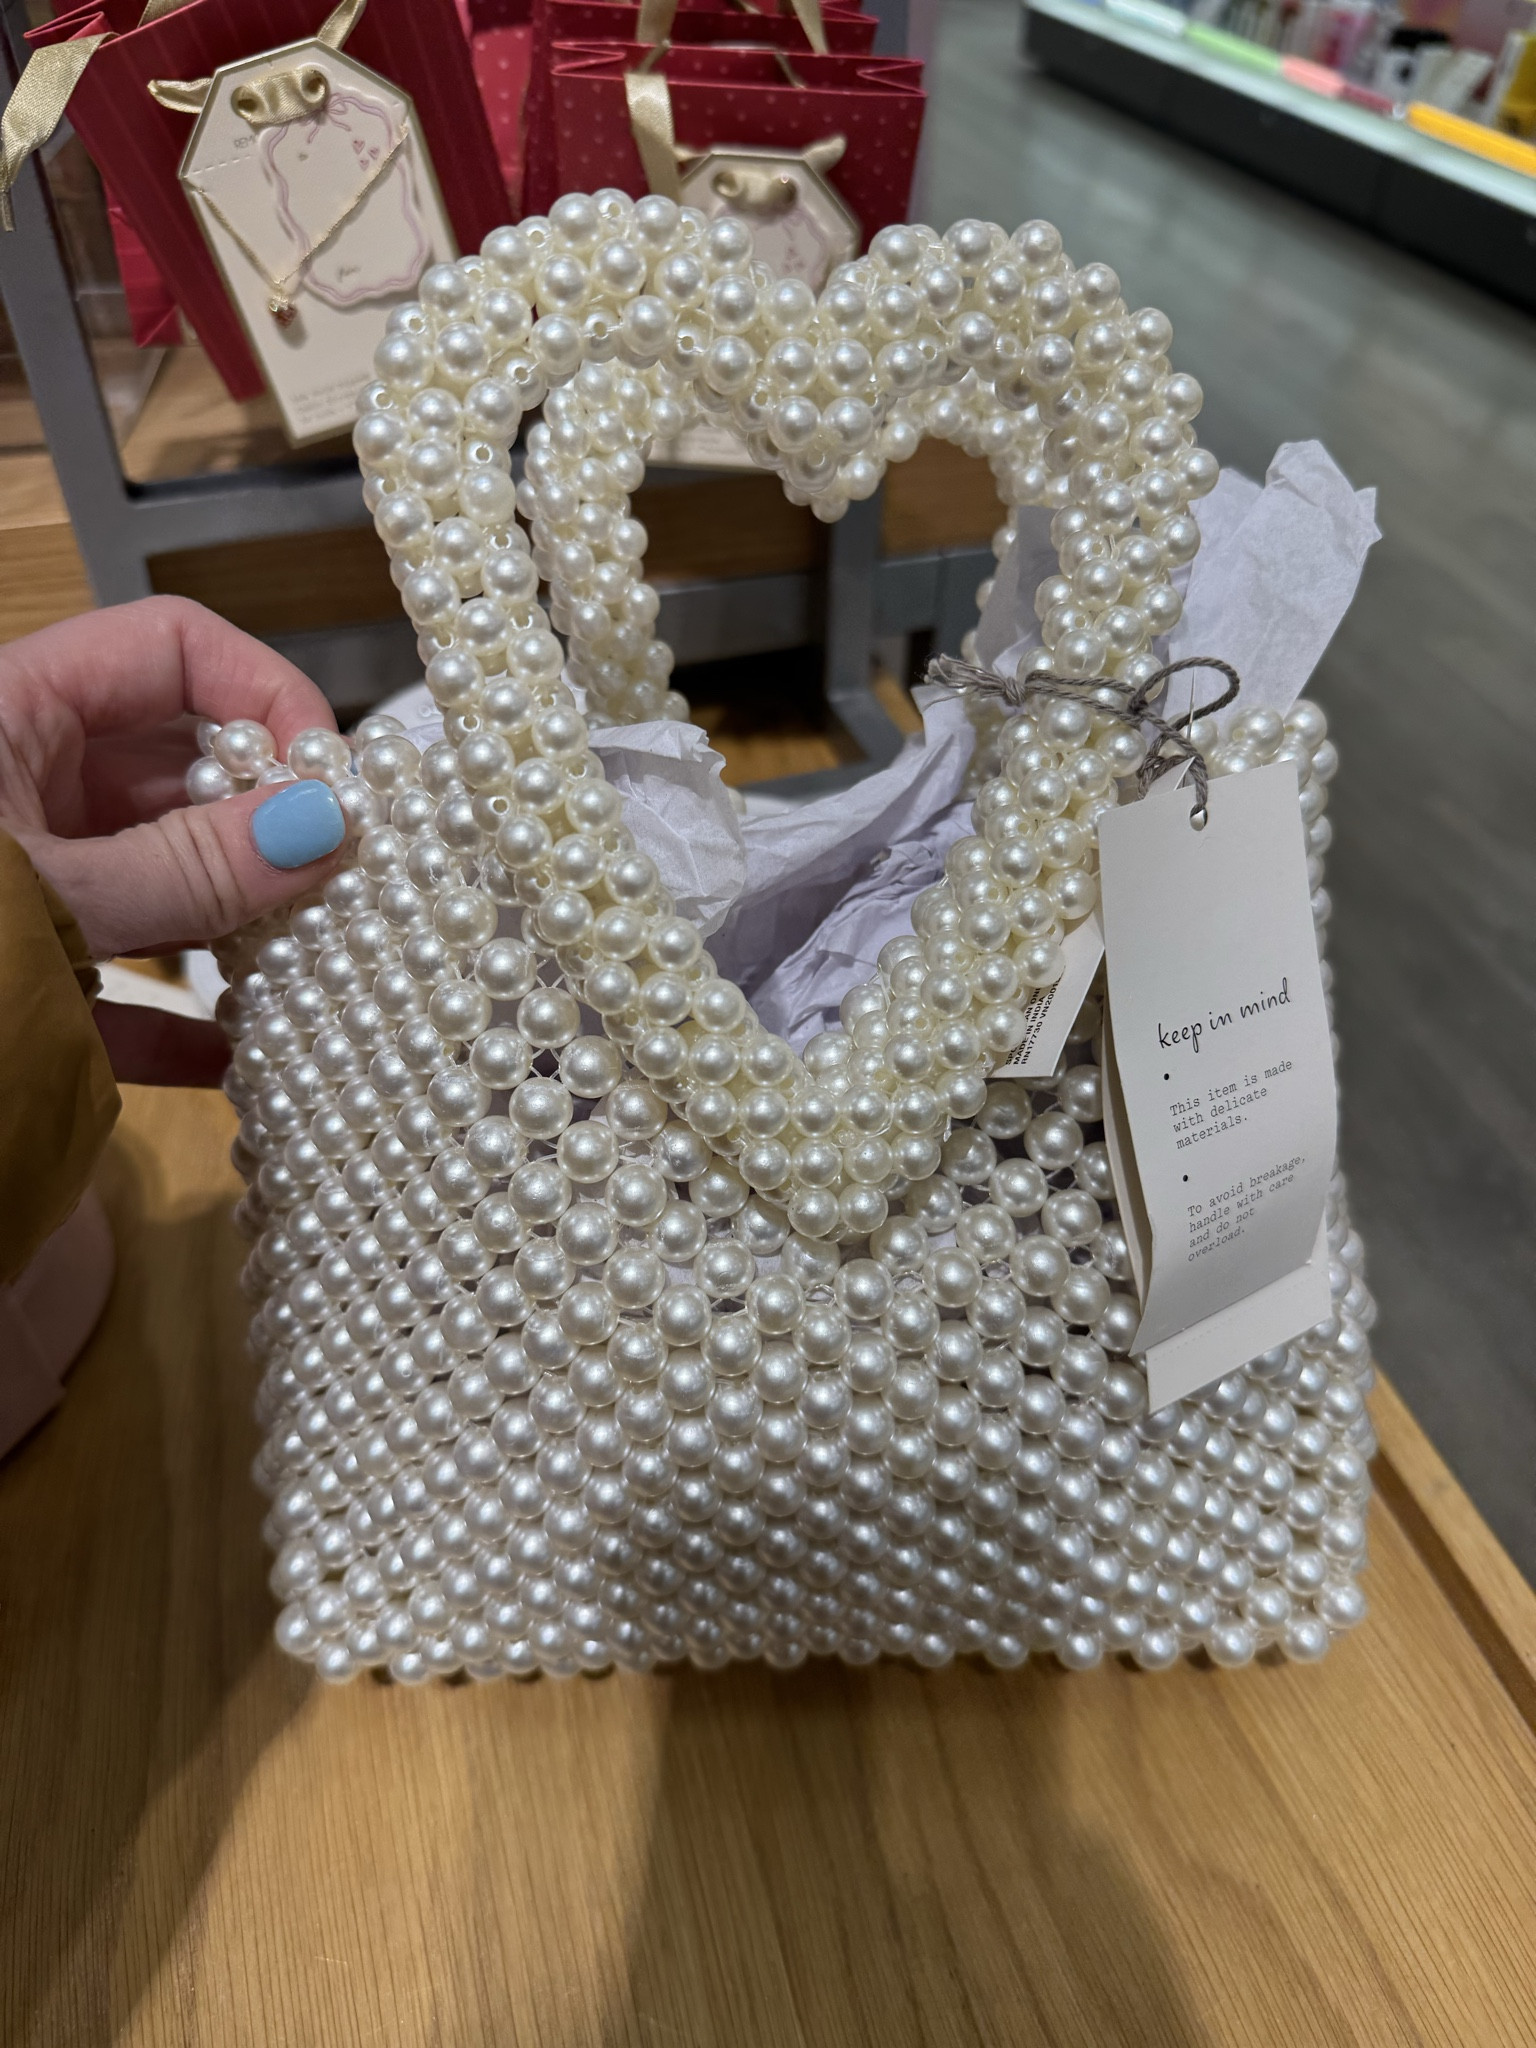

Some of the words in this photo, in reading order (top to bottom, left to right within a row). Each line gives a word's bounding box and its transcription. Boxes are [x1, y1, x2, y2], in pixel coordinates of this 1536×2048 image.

[1013, 1037, 1029, 1065] MADE
[1026, 1025, 1034, 1035] IN
[1031, 995, 1046, 1022] INDIA
[1158, 1022, 1203, 1054] keep
[1208, 1011, 1233, 1031] in
[1239, 976, 1291, 1018] mind
[1021, 1021, 1043, 1065] RN17730
[1169, 1097, 1201, 1117] This
[1207, 1081, 1238, 1102] item
[1243, 1073, 1258, 1087] is
[1264, 1059, 1293, 1079] made
[1173, 1112, 1204, 1133] with
[1210, 1086, 1268, 1118] delicate
[1176, 1113, 1248, 1150] materials.
[1187, 1204, 1202, 1217] To
[1209, 1182, 1244, 1208] avoid
[1249, 1155, 1306, 1188] breakage,
[1189, 1206, 1230, 1233] handle
[1236, 1189, 1263, 1209] with
[1268, 1174, 1294, 1193] care
[1187, 1226, 1245, 1262] overload.
[1189, 1229, 1210, 1248] and
[1216, 1220, 1230, 1234] do
[1235, 1207, 1255, 1224] not
